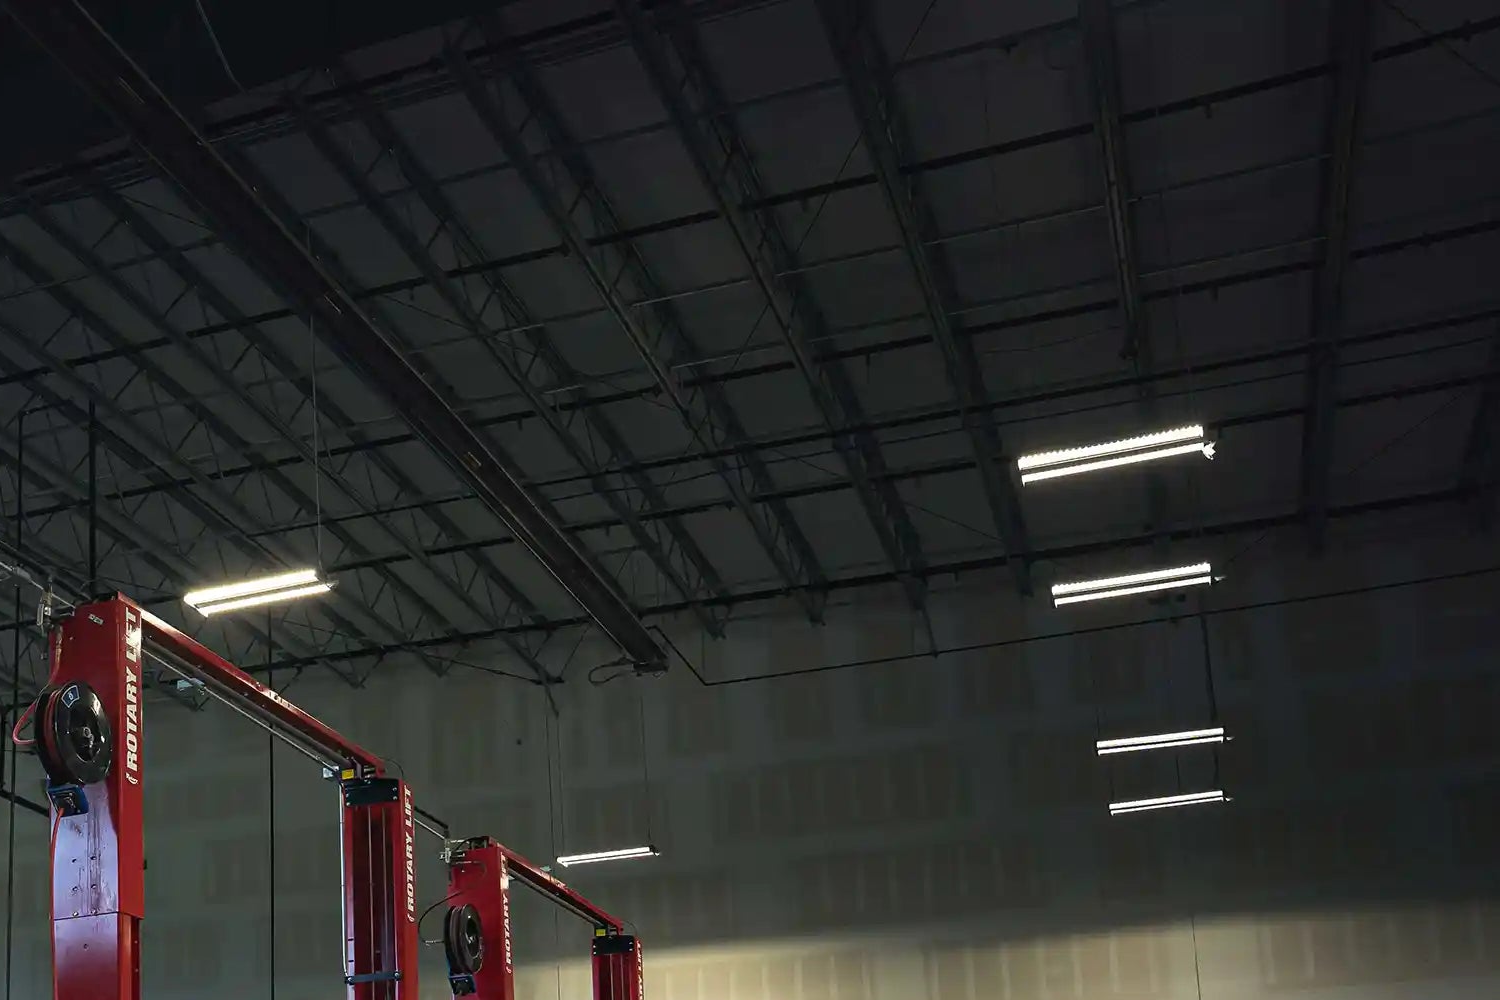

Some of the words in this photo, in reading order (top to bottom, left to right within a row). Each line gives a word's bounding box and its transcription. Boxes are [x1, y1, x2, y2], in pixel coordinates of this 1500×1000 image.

[126, 666, 138, 771] ROTARY
[404, 785, 413, 827] LIFT
[404, 829, 415, 912] ROTARY
[502, 893, 512, 964] ROTARY
